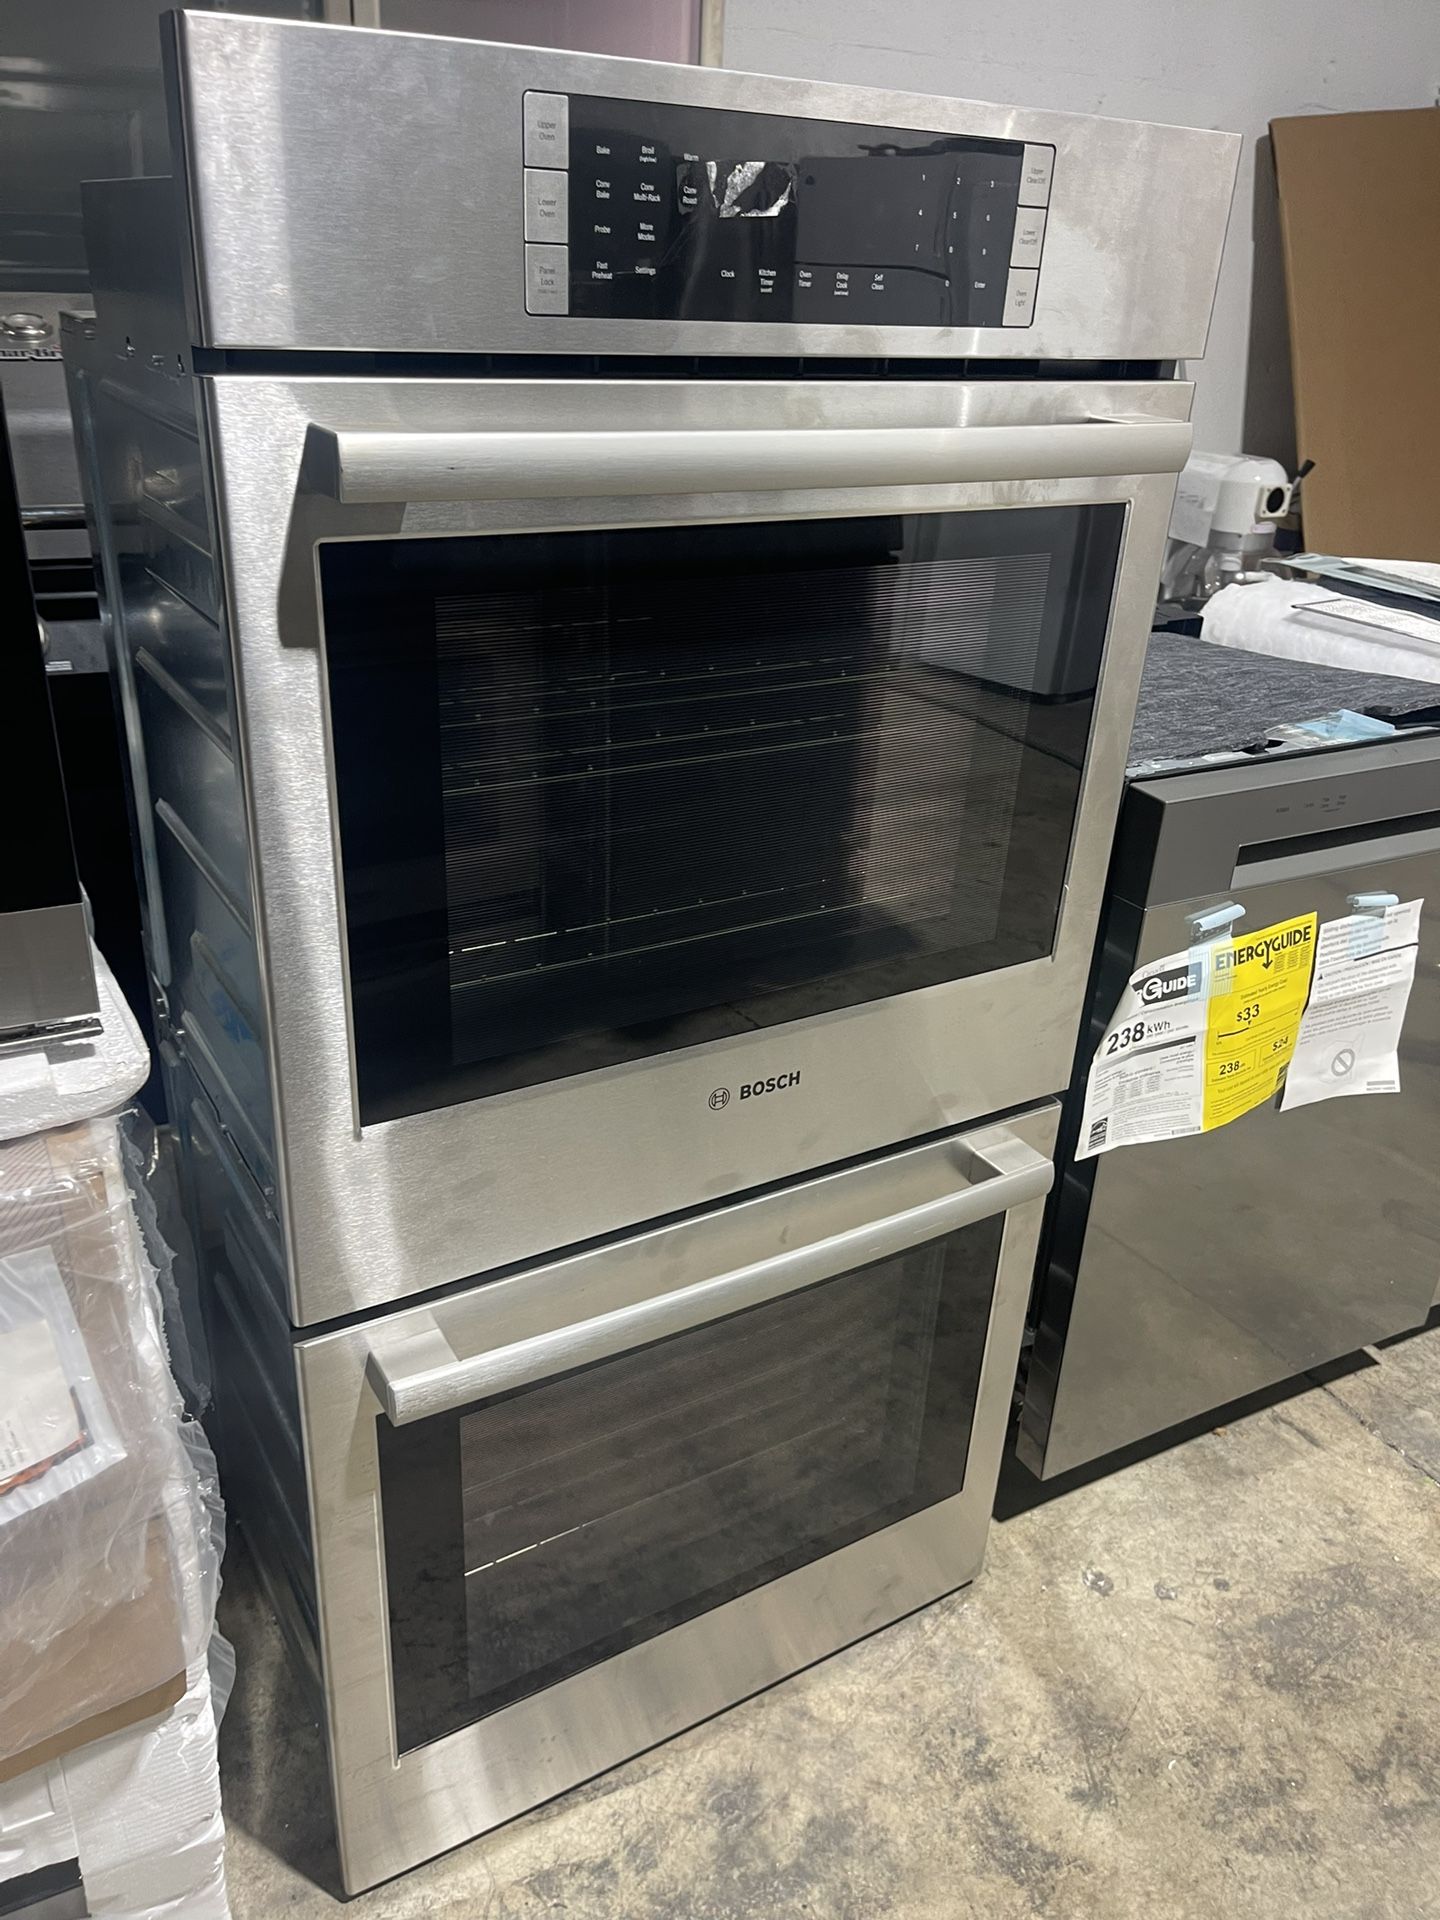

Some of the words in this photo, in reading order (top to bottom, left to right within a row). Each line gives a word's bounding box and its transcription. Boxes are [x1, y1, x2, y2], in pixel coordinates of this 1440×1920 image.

[537, 120, 557, 129] Upper
[539, 131, 556, 141] Oven
[596, 145, 610, 155] Bake
[641, 145, 655, 154] Broil
[596, 190, 610, 199] Bake
[538, 199, 556, 207] Lower
[539, 209, 556, 218] Oven
[594, 225, 611, 234] Probe
[596, 261, 609, 269] Fast
[592, 271, 613, 280] Preheat
[635, 266, 656, 276] Settings
[721, 269, 735, 278] Clock
[799, 270, 812, 278] Oven
[541, 278, 554, 286] Lock
[760, 278, 774, 286] Timer
[799, 279, 812, 288] Timer
[1214, 924, 1313, 971] ENERGYGUIDE
[1236, 1003, 1260, 1022] $33
[1106, 1021, 1146, 1056] 238
[1146, 1020, 1171, 1035] kWh
[1218, 1060, 1240, 1076] 238
[740, 1070, 800, 1101] BOSCH
